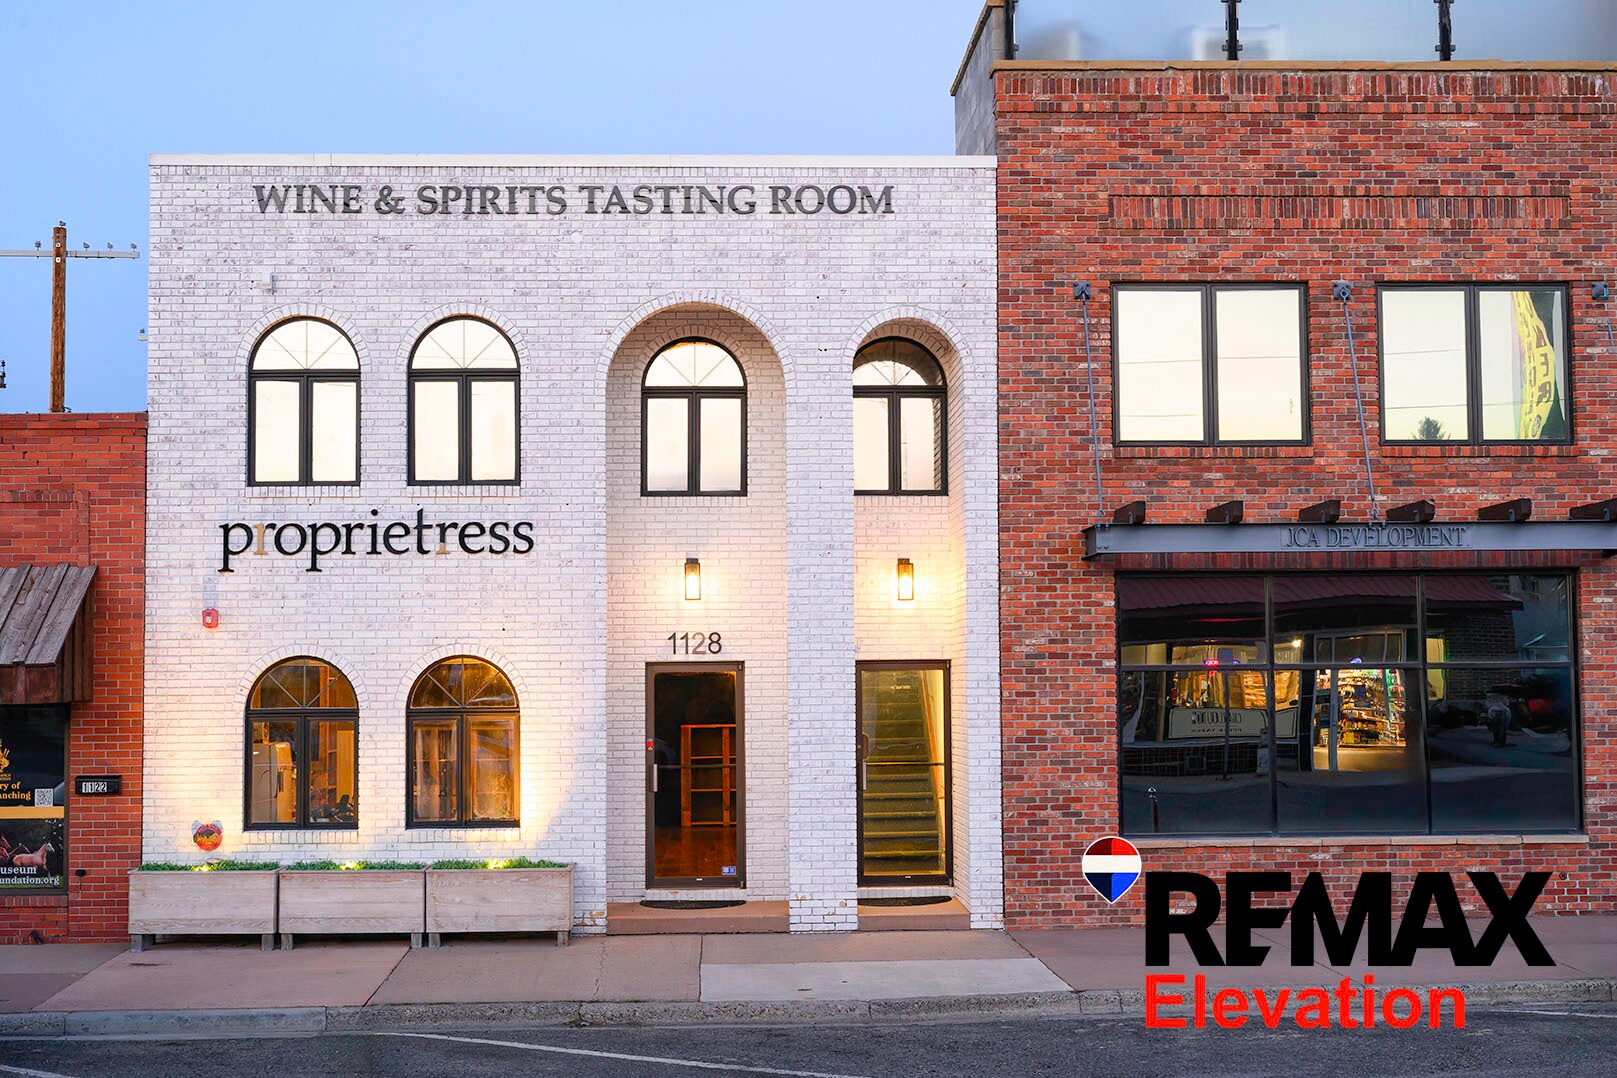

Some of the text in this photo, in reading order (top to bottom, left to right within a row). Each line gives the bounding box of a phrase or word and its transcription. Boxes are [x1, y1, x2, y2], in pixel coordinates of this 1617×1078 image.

[252, 184, 895, 214] WINE & SPIRITS TASTING ROOM
[217, 507, 535, 573] proprietress
[1286, 526, 1467, 548] JCA DEVELOPMENT
[667, 631, 723, 655] 1128
[11, 781, 21, 790] of
[82, 781, 108, 793] 1122
